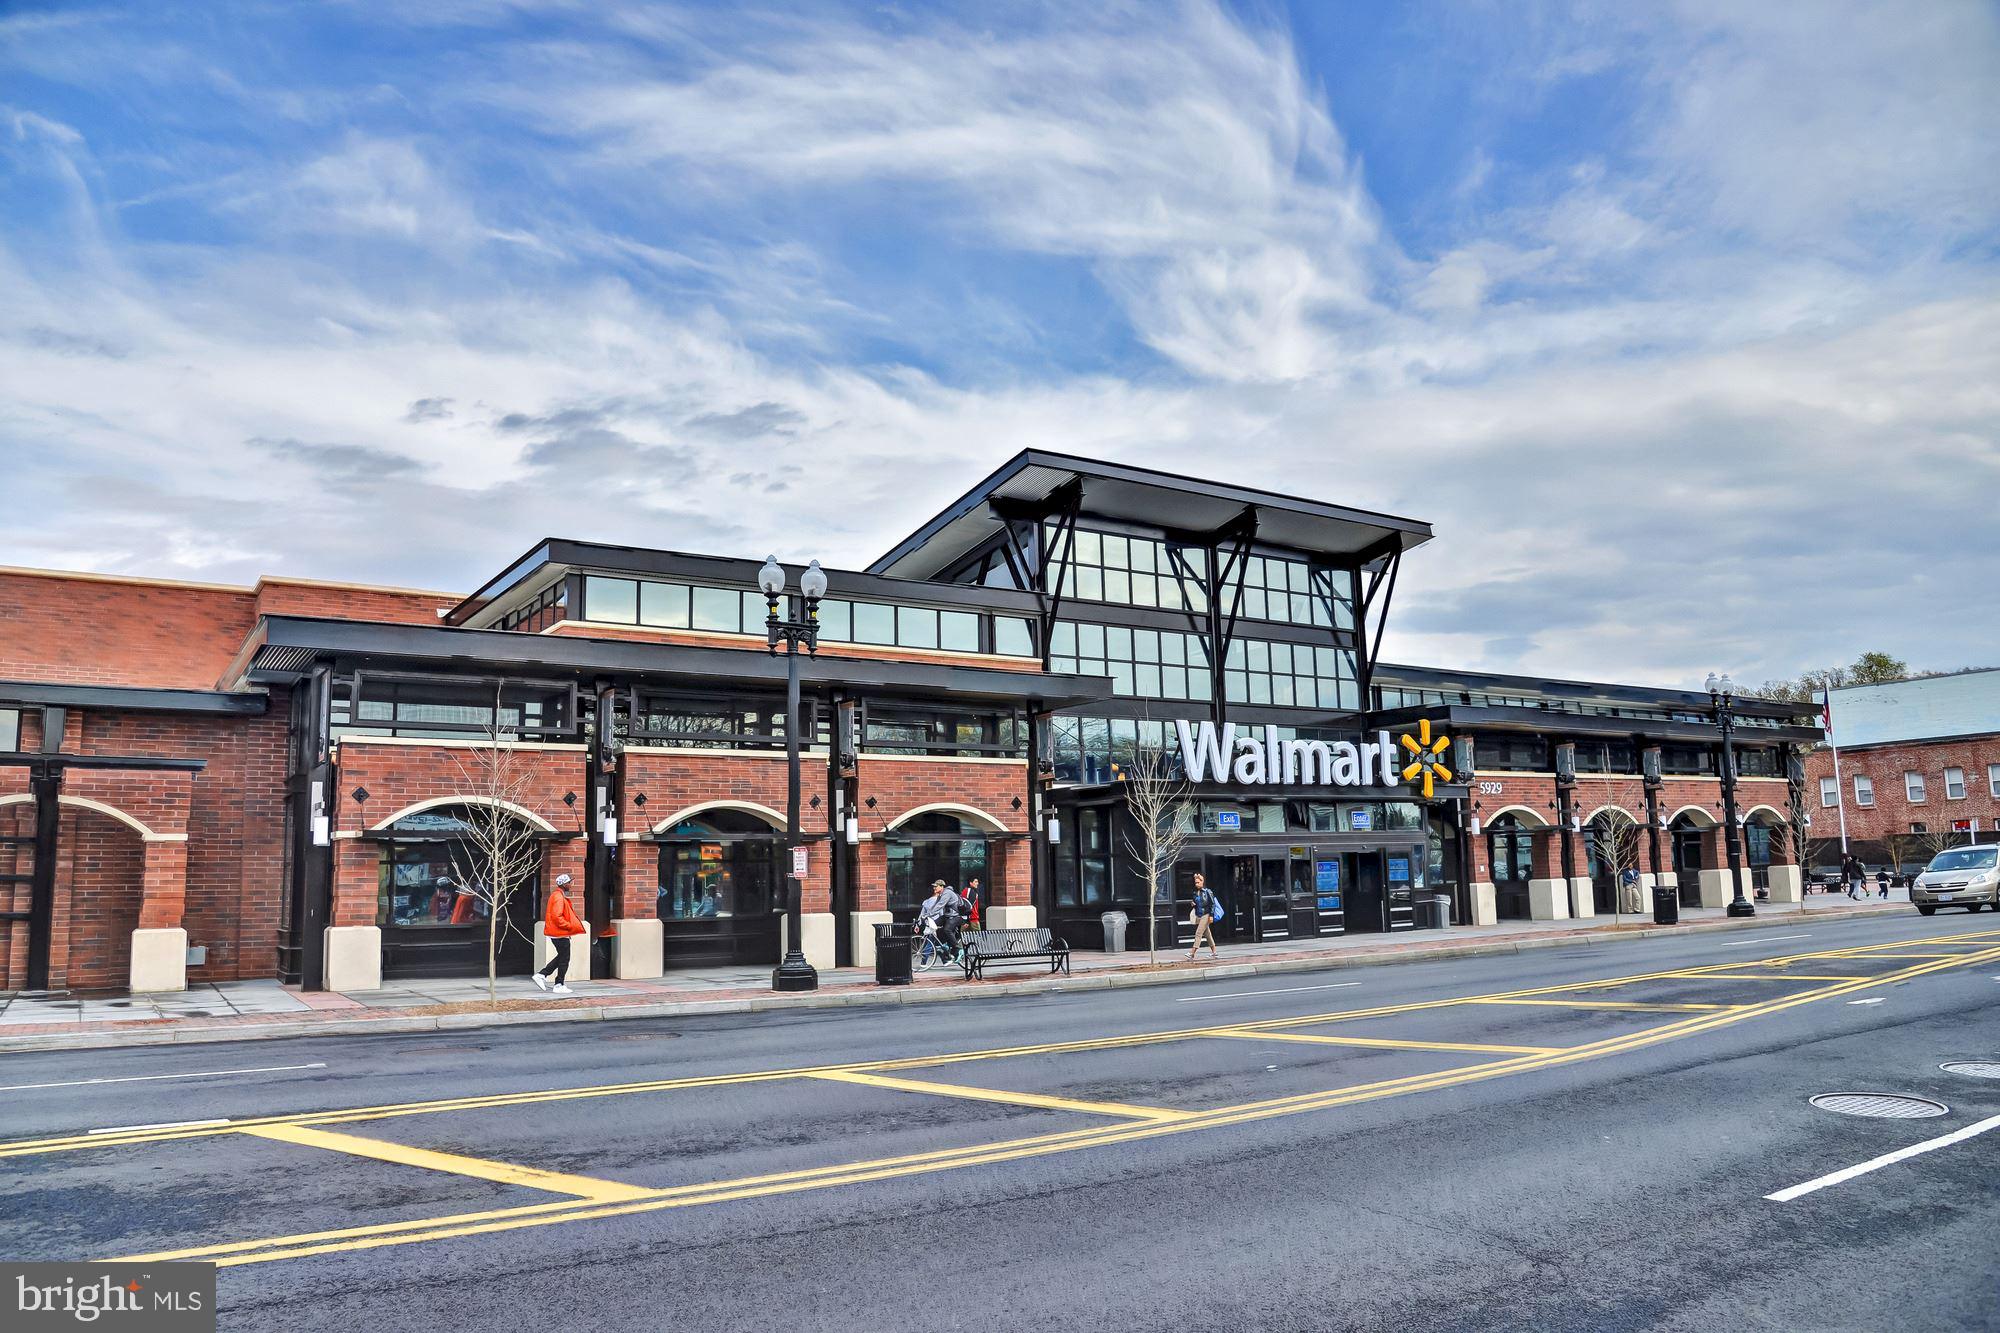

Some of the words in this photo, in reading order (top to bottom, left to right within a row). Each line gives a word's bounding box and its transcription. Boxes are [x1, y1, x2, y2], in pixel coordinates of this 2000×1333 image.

[1176, 719, 1399, 787] Walmart
[1480, 782, 1502, 794] 5929
[1223, 814, 1235, 823] Exit
